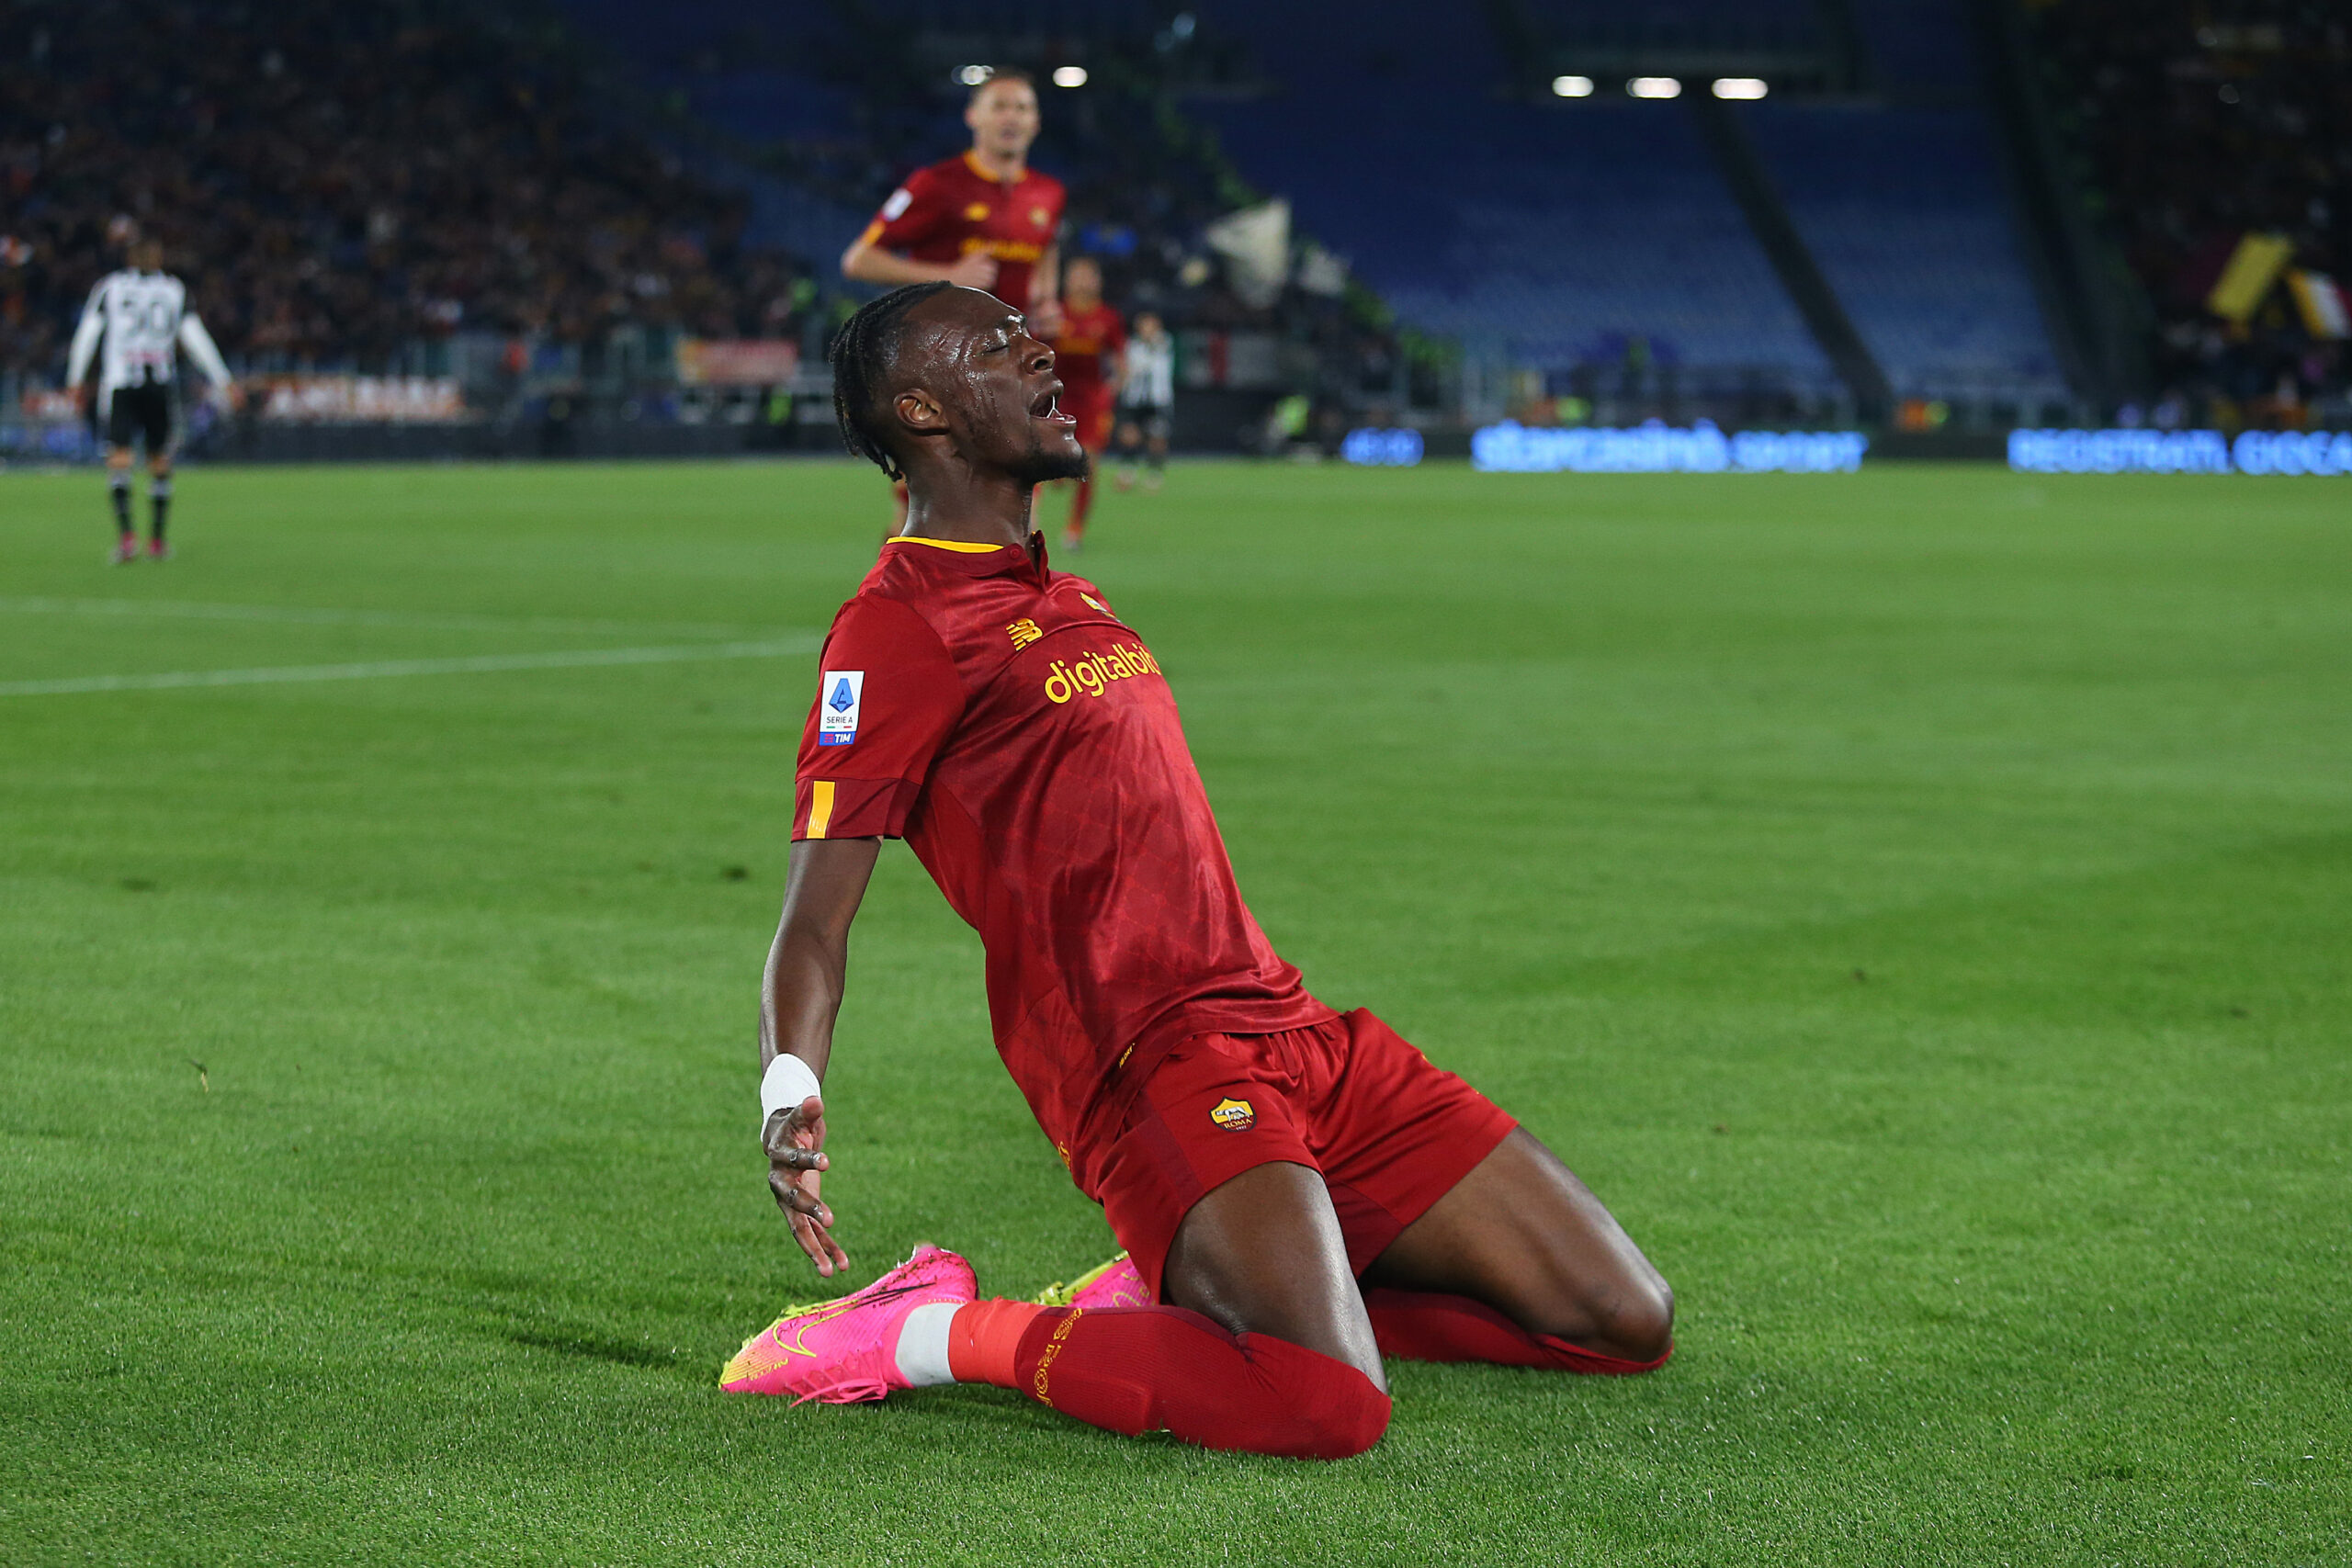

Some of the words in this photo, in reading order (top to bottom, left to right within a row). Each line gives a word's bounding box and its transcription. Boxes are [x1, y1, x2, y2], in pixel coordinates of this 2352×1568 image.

[1045, 642, 1161, 704] digitalbit
[826, 716, 847, 724] SERIE
[848, 716, 854, 724] A
[834, 733, 852, 744] TIM
[1224, 1118, 1252, 1129] ROMA
